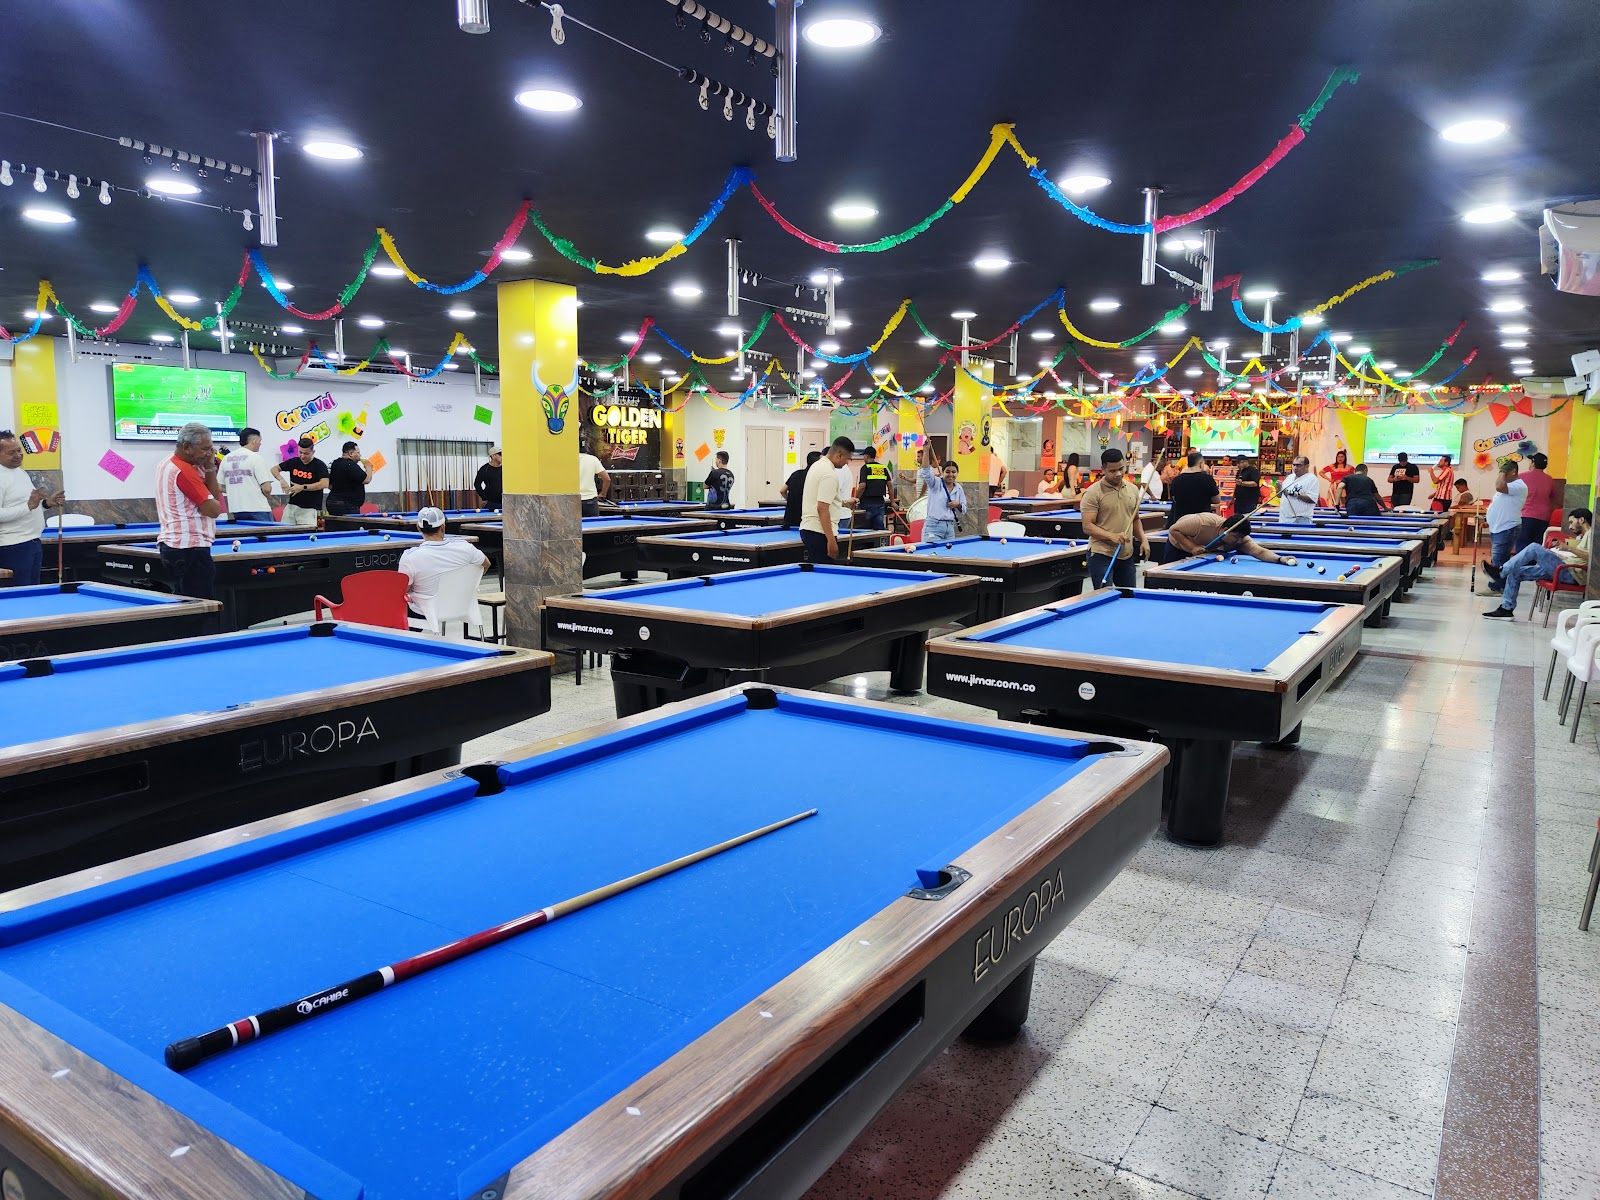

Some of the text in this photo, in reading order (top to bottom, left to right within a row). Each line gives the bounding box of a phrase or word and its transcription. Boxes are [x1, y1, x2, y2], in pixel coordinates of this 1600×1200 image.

[554, 27, 564, 42] 10
[276, 392, 338, 431] Carnaval
[592, 404, 662, 429] GOLDEN
[607, 428, 648, 445] TIGER
[292, 468, 313, 480] BOSS
[557, 622, 614, 636] www.jimar.com.co
[945, 672, 1036, 693] www.jimar.com.co
[238, 716, 380, 771] EUROPA
[973, 868, 1066, 983] EUROPA
